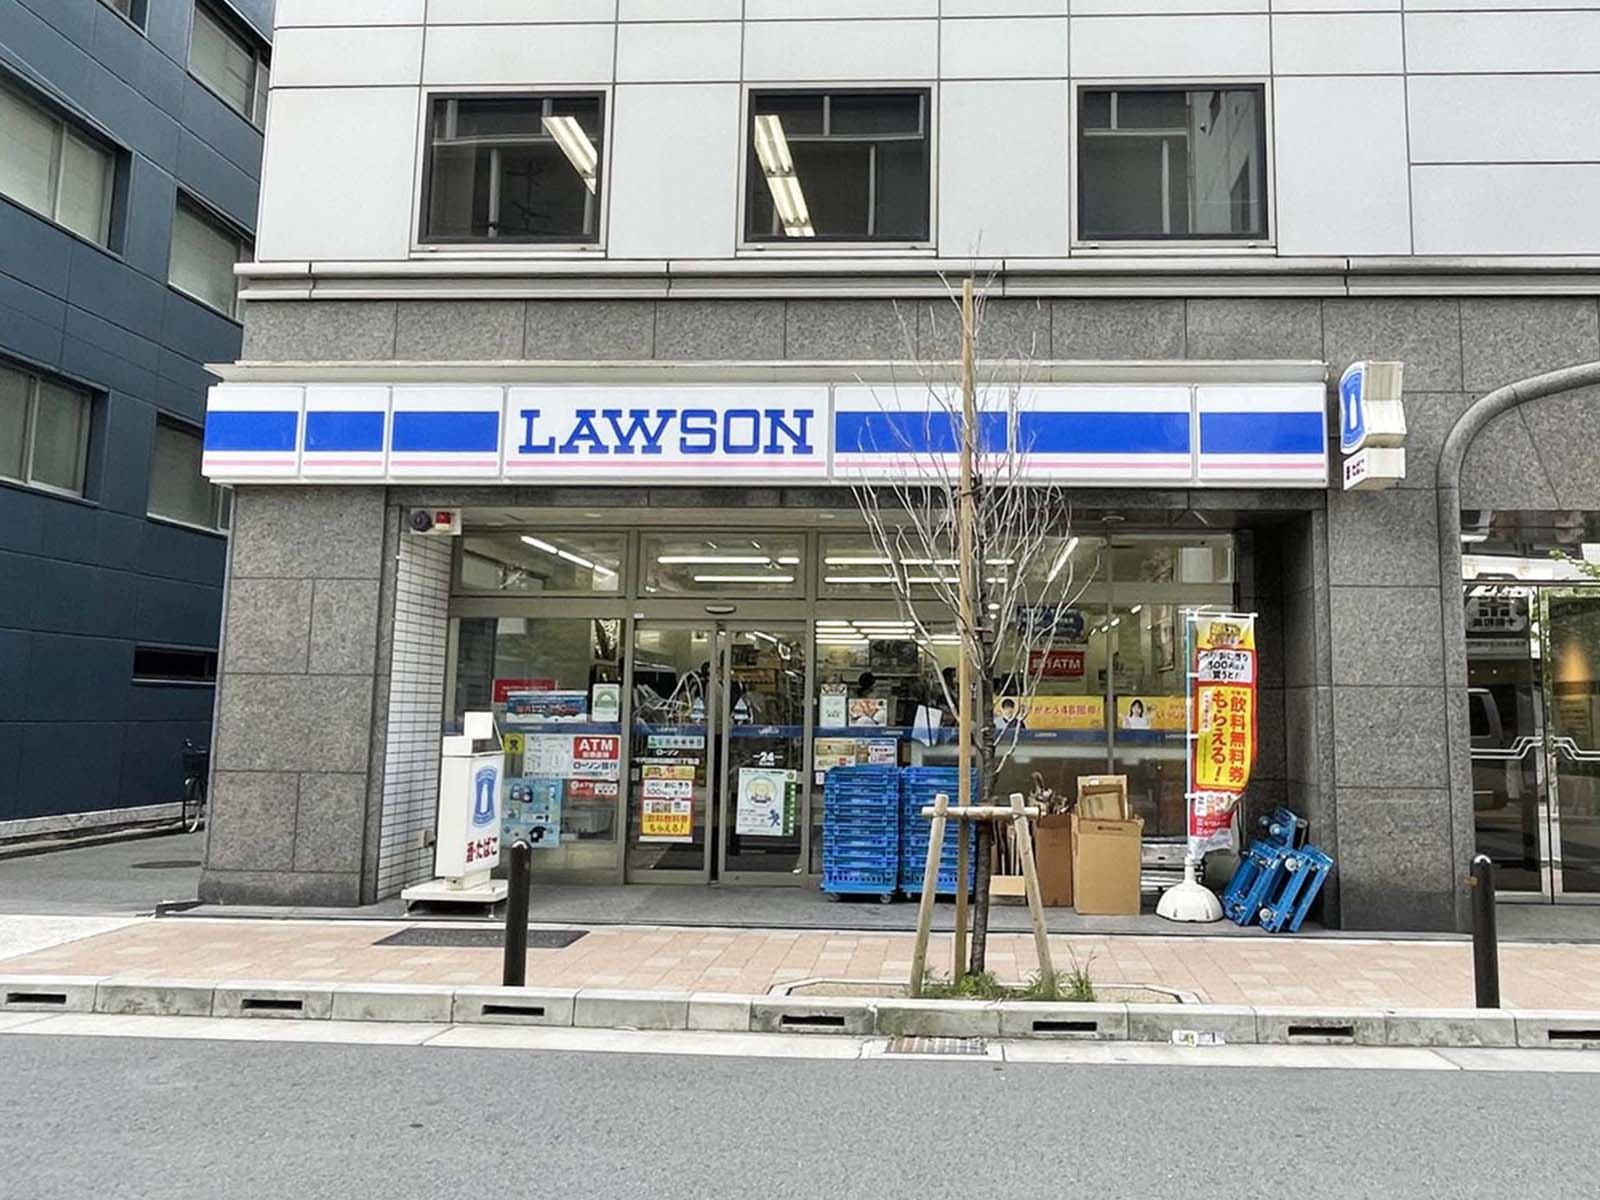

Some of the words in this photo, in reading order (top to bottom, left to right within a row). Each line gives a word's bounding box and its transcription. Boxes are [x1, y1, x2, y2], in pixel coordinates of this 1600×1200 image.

[518, 409, 814, 454] LAWSON
[579, 738, 613, 751] ATM
[759, 751, 775, 762] 24
[1212, 690, 1228, 782] もらえる!
[1229, 696, 1247, 783] 飲料無料券
